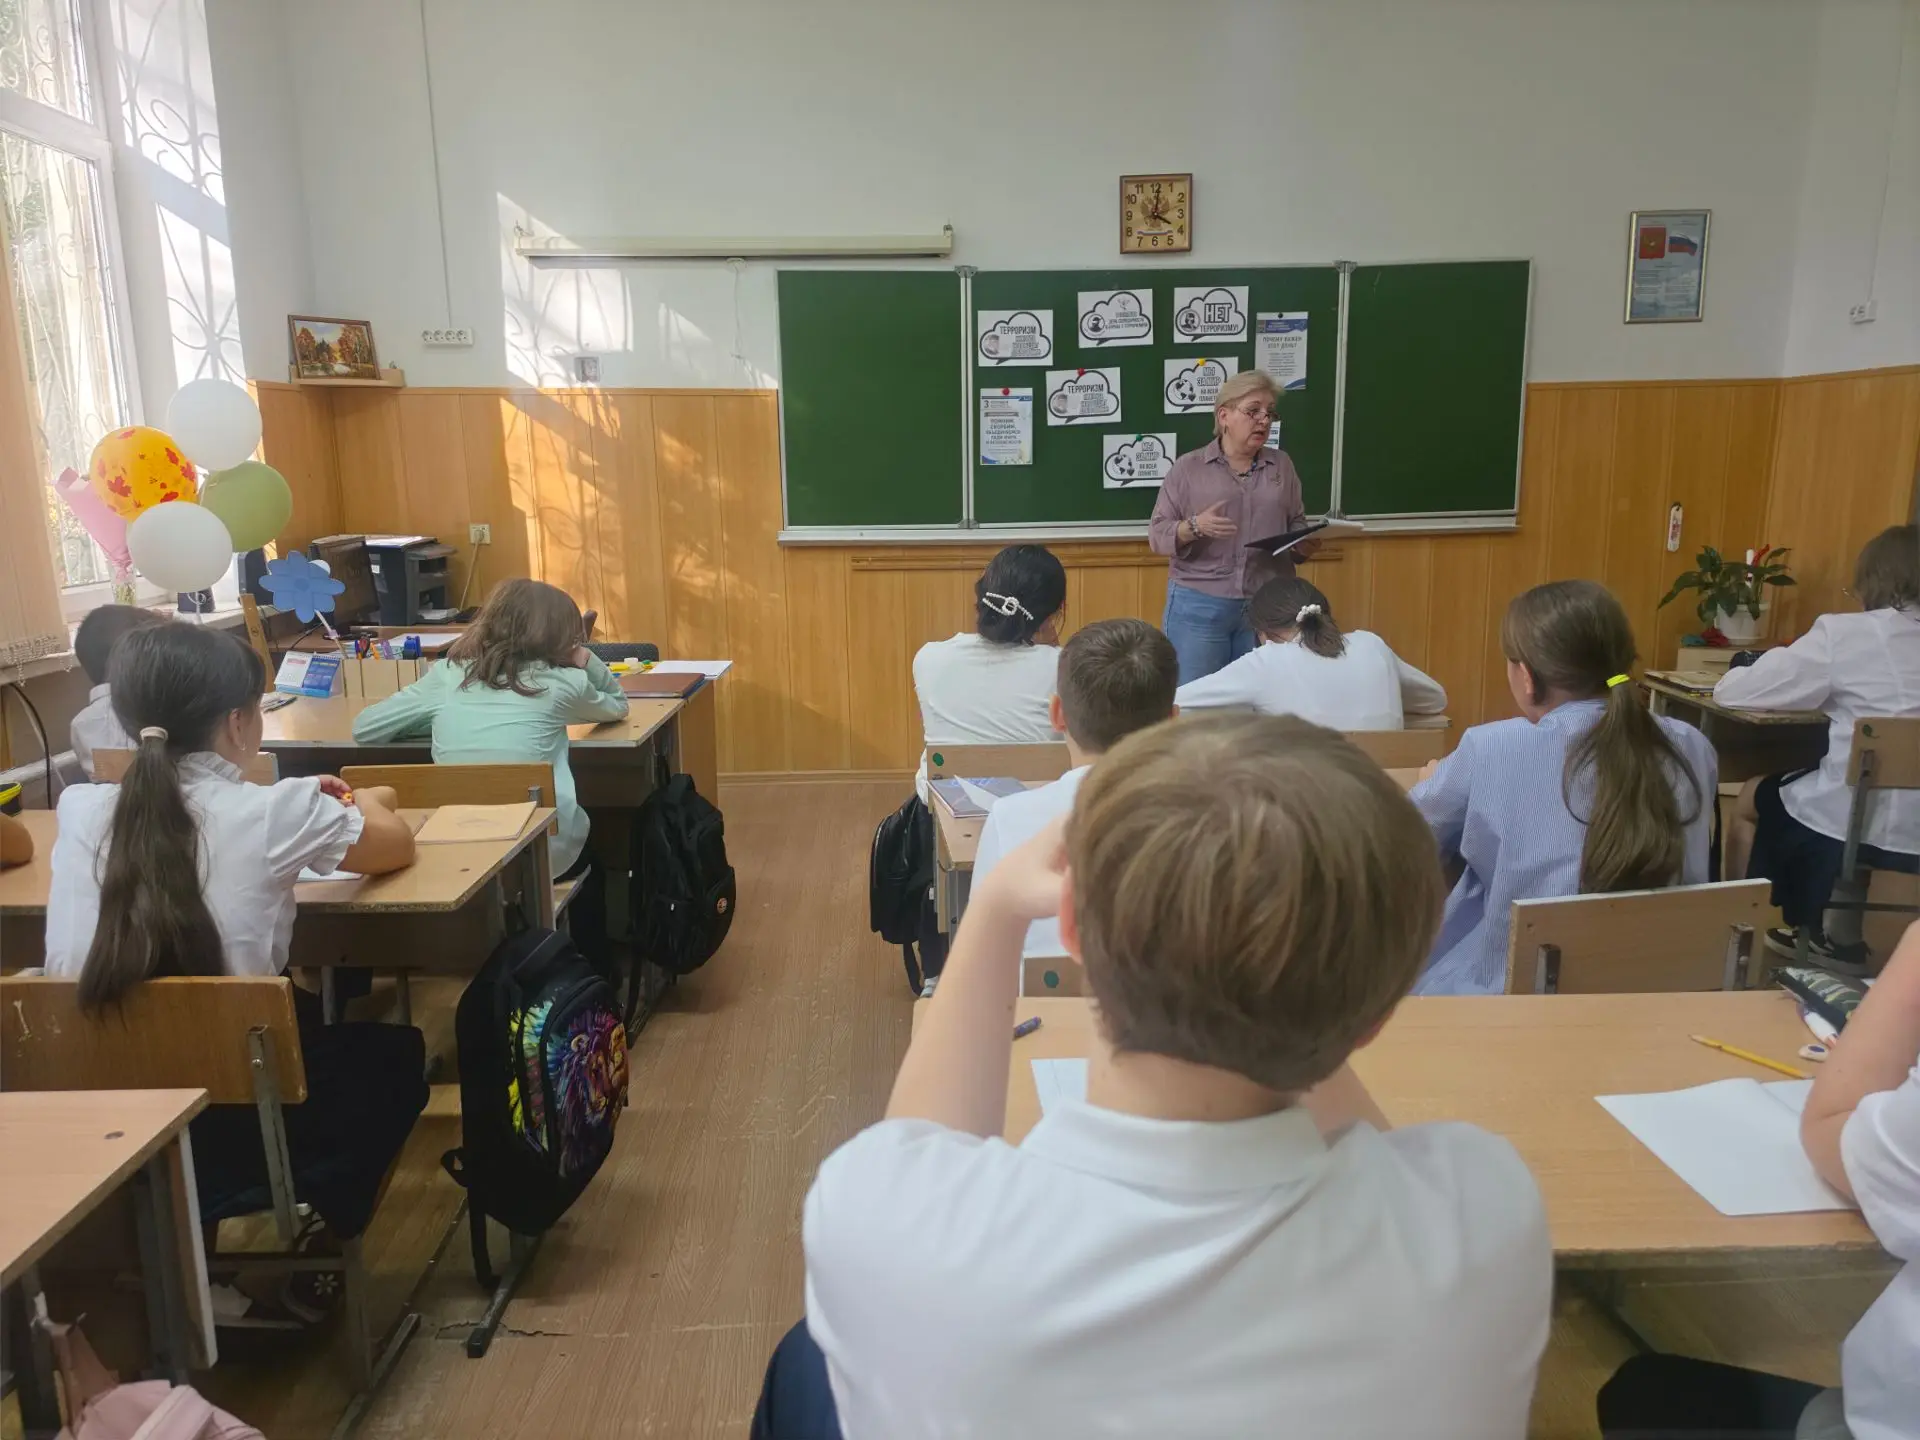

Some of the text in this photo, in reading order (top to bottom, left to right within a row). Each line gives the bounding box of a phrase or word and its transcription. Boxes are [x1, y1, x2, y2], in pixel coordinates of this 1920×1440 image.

[1134, 183, 1144, 194] 11
[1150, 182, 1162, 194] 12
[1168, 183, 1174, 193] 1
[1125, 194, 1137, 204] 10
[1177, 192, 1185, 203] 2
[1126, 210, 1133, 221] 9
[1177, 208, 1184, 219] 3
[1126, 227, 1133, 237] 8
[1177, 225, 1184, 235] 4
[1136, 236, 1143, 248] 7
[1151, 236, 1158, 246] 6
[1167, 235, 1174, 246] 5
[1203, 303, 1232, 323] НЕТ
[1000, 326, 1036, 335] ТЕРРОРИЗМ
[1200, 324, 1238, 333] ТЕРРОРИЗМУ!
[1068, 384, 1104, 394] ТЕРРОРИЗМ
[983, 400, 989, 408] 3
